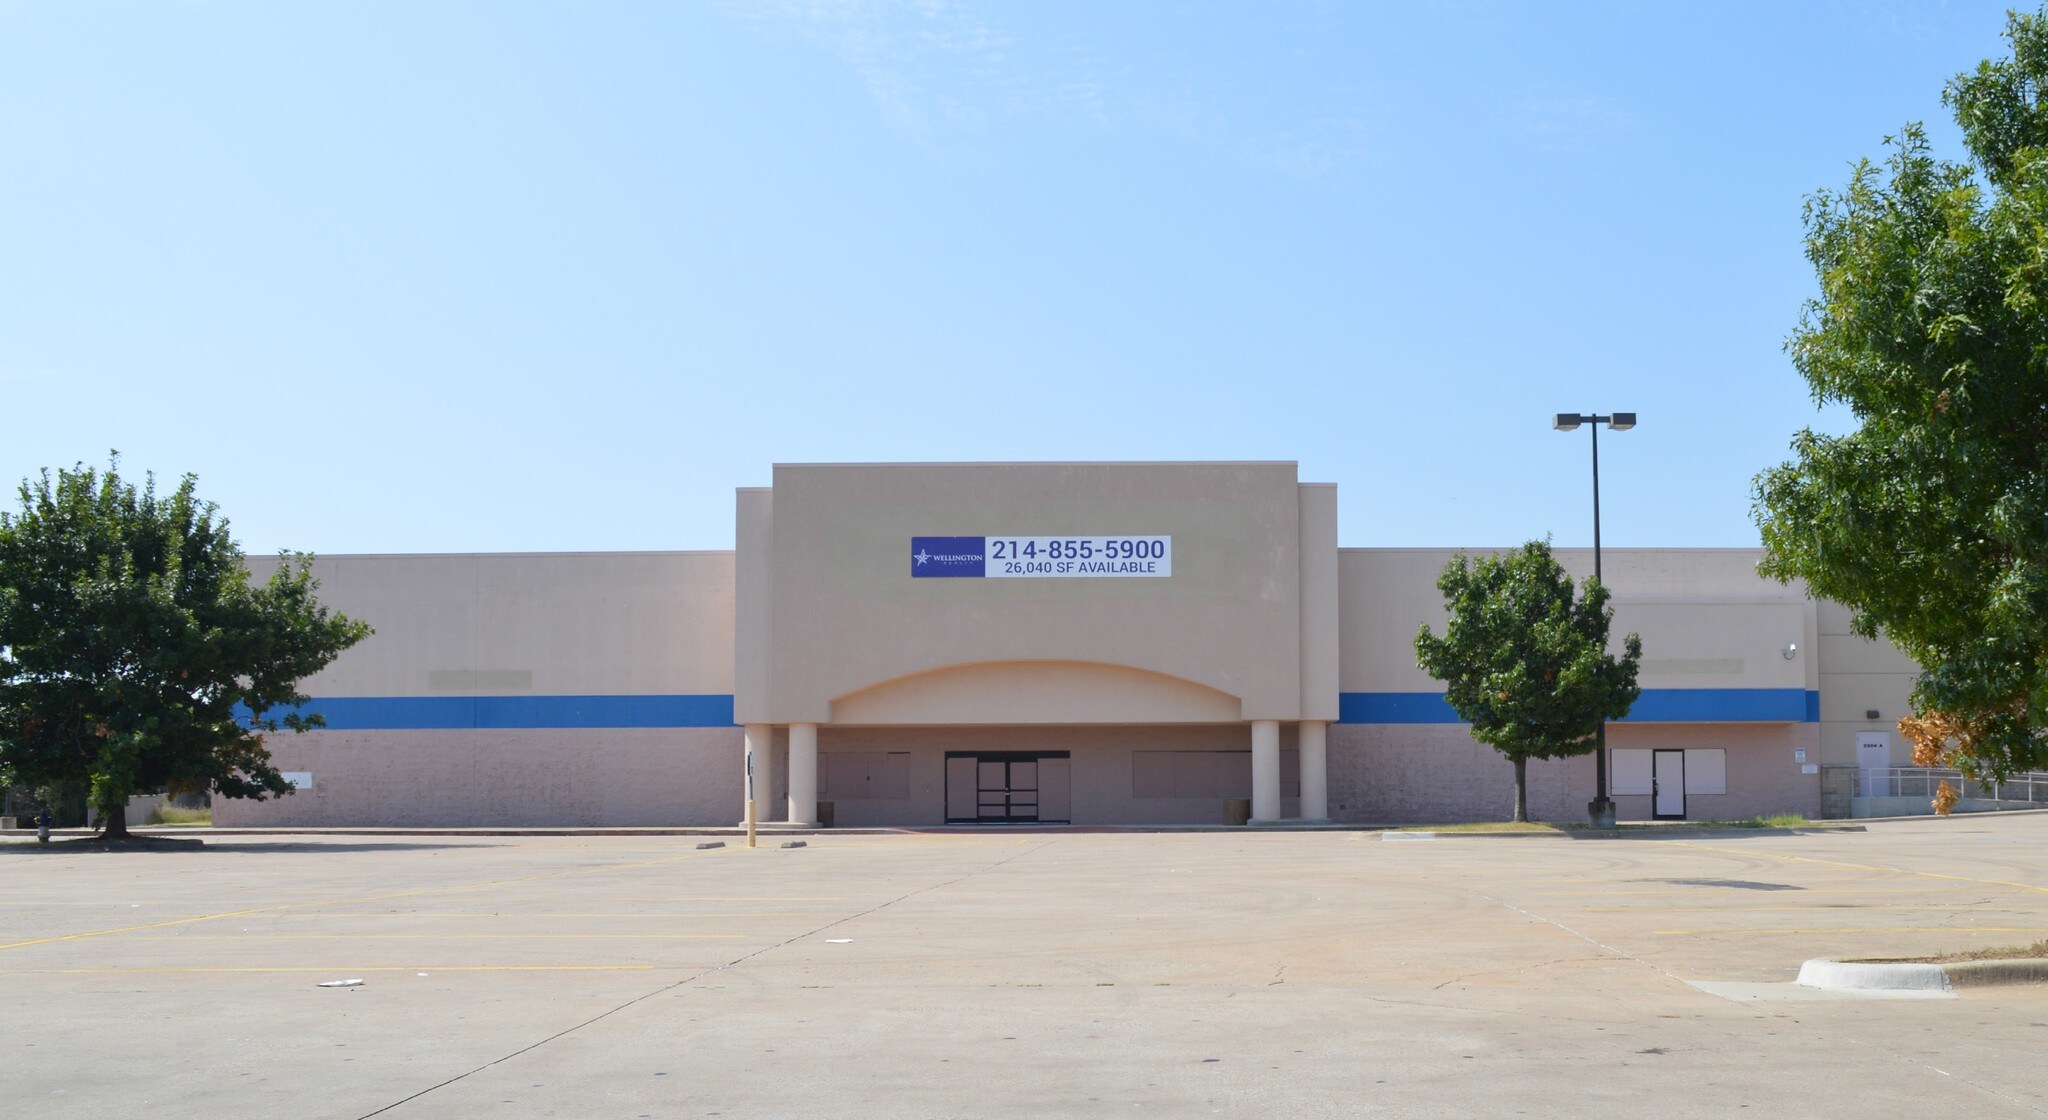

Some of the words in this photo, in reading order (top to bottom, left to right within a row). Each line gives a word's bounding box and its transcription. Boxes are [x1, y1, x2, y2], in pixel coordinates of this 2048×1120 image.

[992, 540, 1165, 560] 214-855-5900
[933, 554, 983, 562] WELLINGTON
[1005, 561, 1052, 575] 26,040
[1056, 561, 1075, 574] SF
[1078, 561, 1156, 573] AVAILABLE
